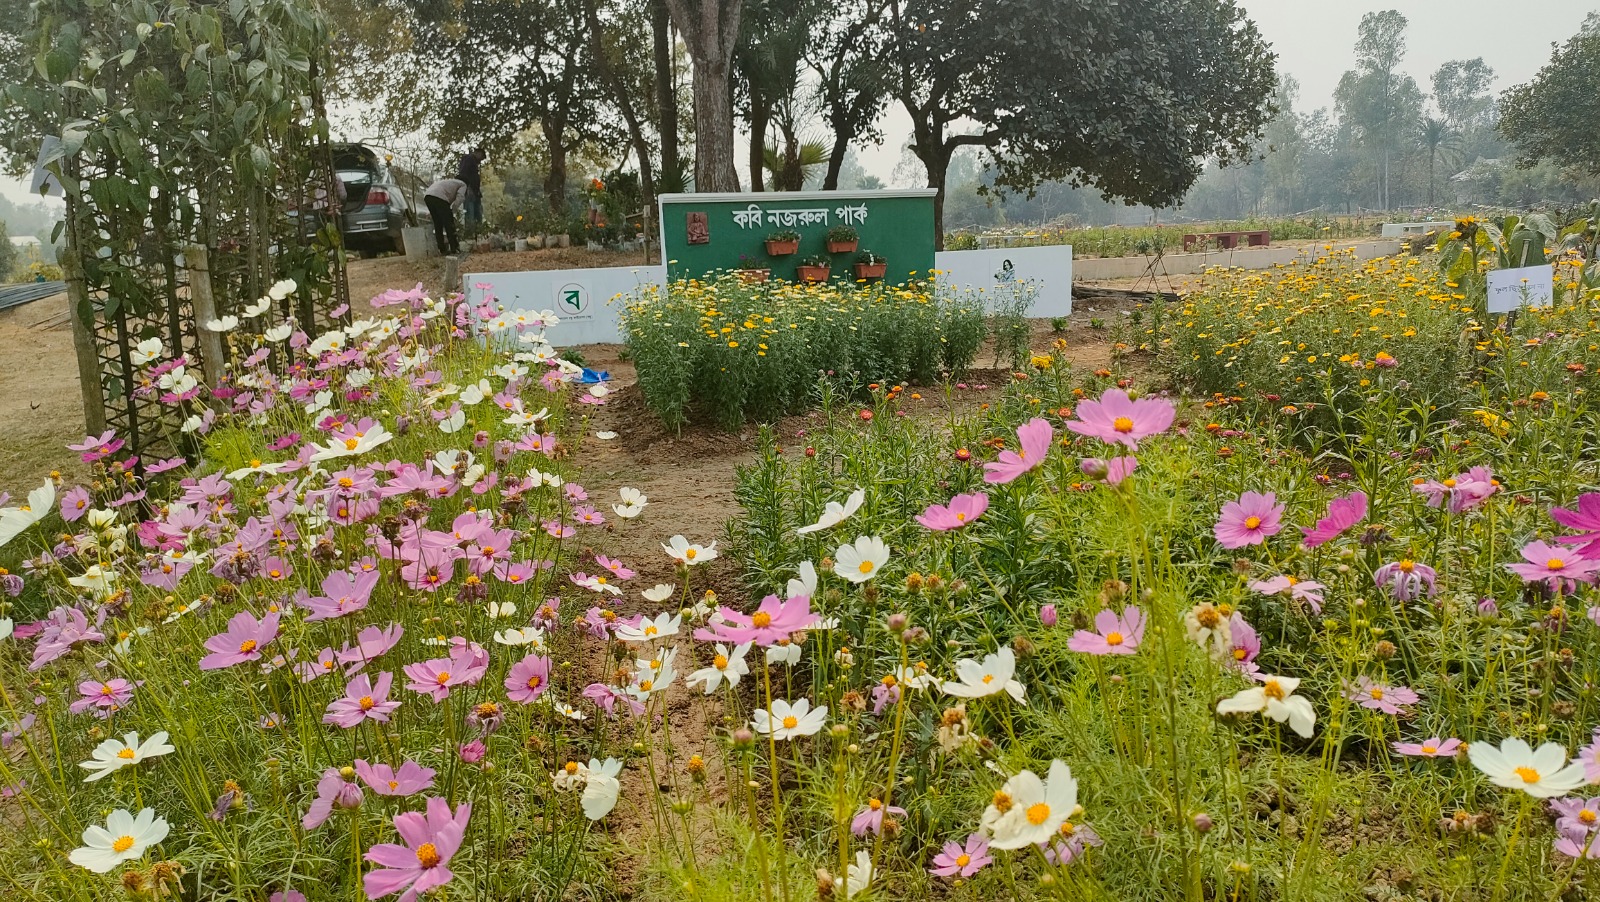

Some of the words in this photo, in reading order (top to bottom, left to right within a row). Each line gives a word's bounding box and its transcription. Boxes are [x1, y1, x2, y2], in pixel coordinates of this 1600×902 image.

[732, 204, 763, 229] কবি
[766, 208, 829, 228] নজরুল
[835, 202, 868, 225] পার্ক
